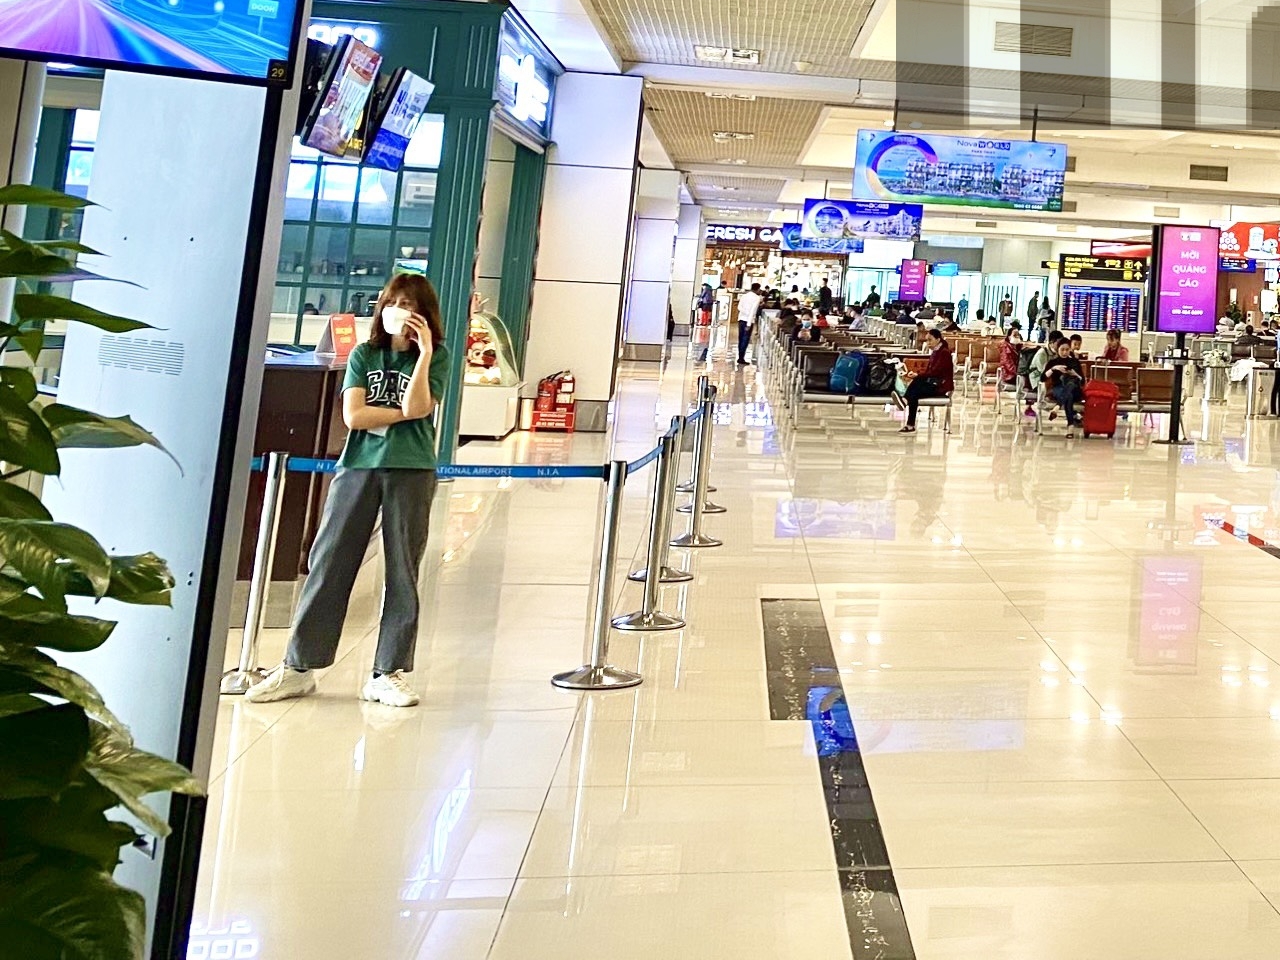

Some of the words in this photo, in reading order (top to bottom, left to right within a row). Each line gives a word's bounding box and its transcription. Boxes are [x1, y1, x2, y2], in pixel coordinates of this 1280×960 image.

[251, 3, 275, 13] DOOH
[271, 67, 284, 78] 29
[705, 226, 755, 241] FRESH
[472, 467, 512, 476] AIRPORT
